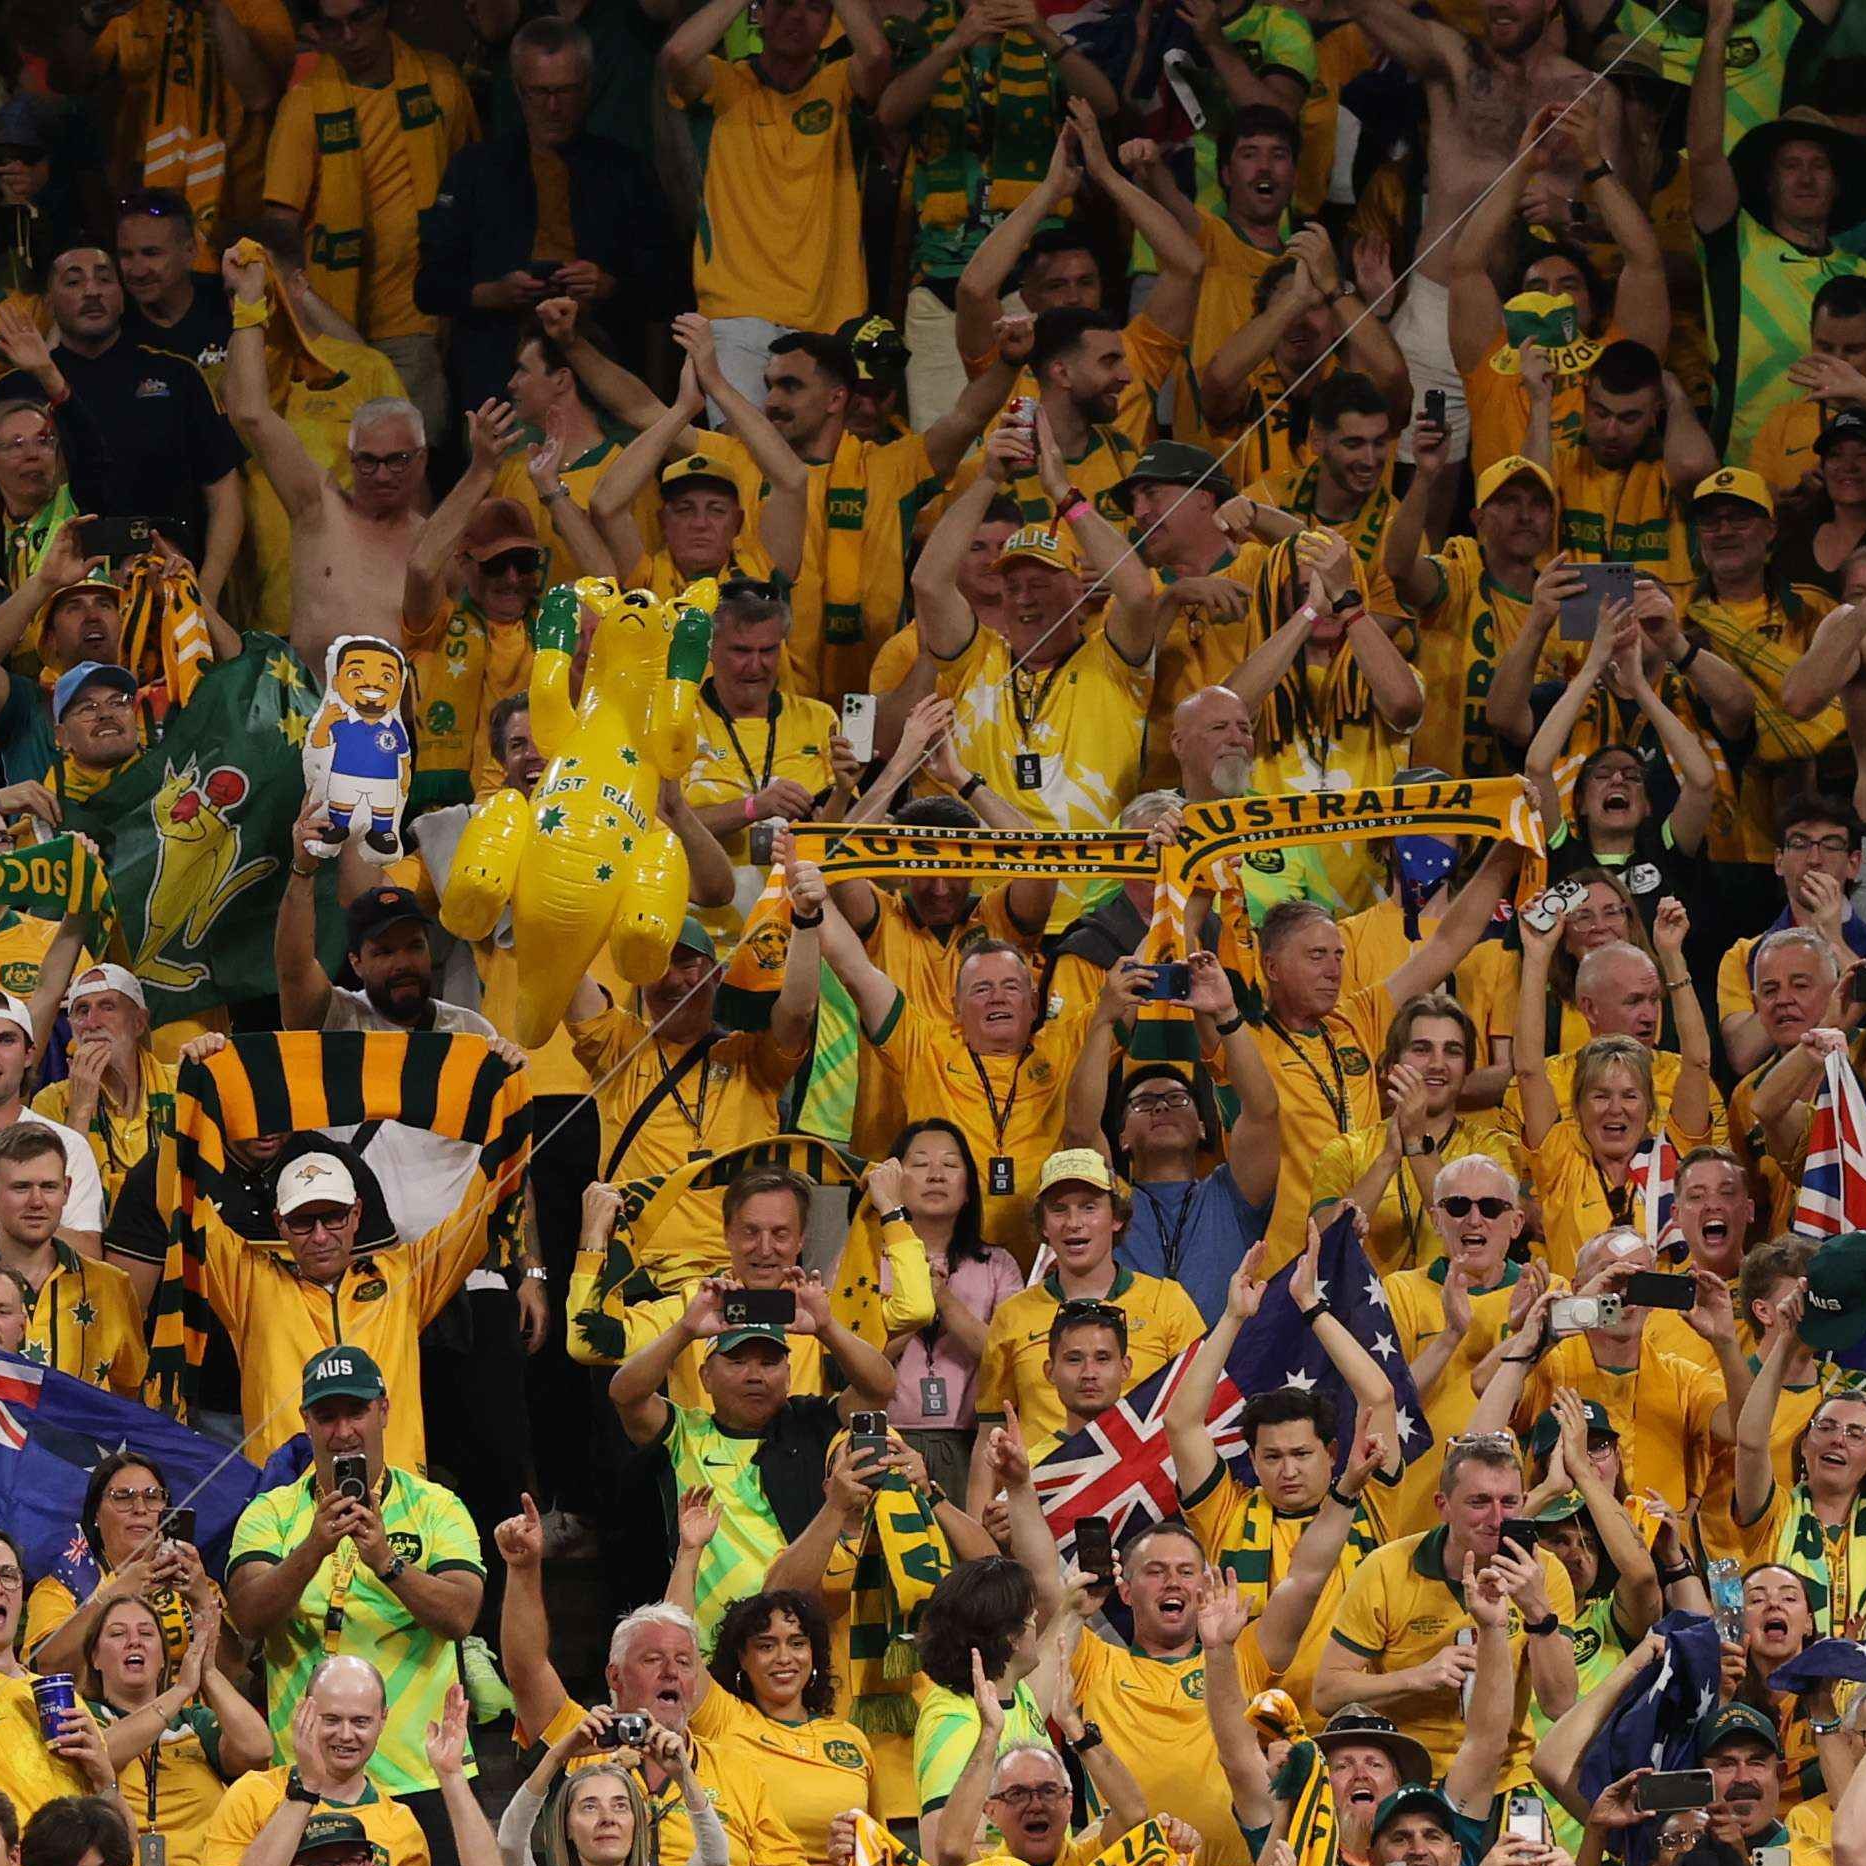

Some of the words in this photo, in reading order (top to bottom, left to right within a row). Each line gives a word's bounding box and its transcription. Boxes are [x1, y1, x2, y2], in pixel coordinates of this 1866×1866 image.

[1175, 781, 1474, 853] AUSTRALIA
[1321, 818, 1377, 836] WORLD
[1385, 814, 1415, 828] CUP
[1054, 830, 1107, 842] ARMY
[998, 861, 1059, 874] WORLD
[1069, 862, 1101, 874] CUP
[316, 1358, 354, 1381] AUS
